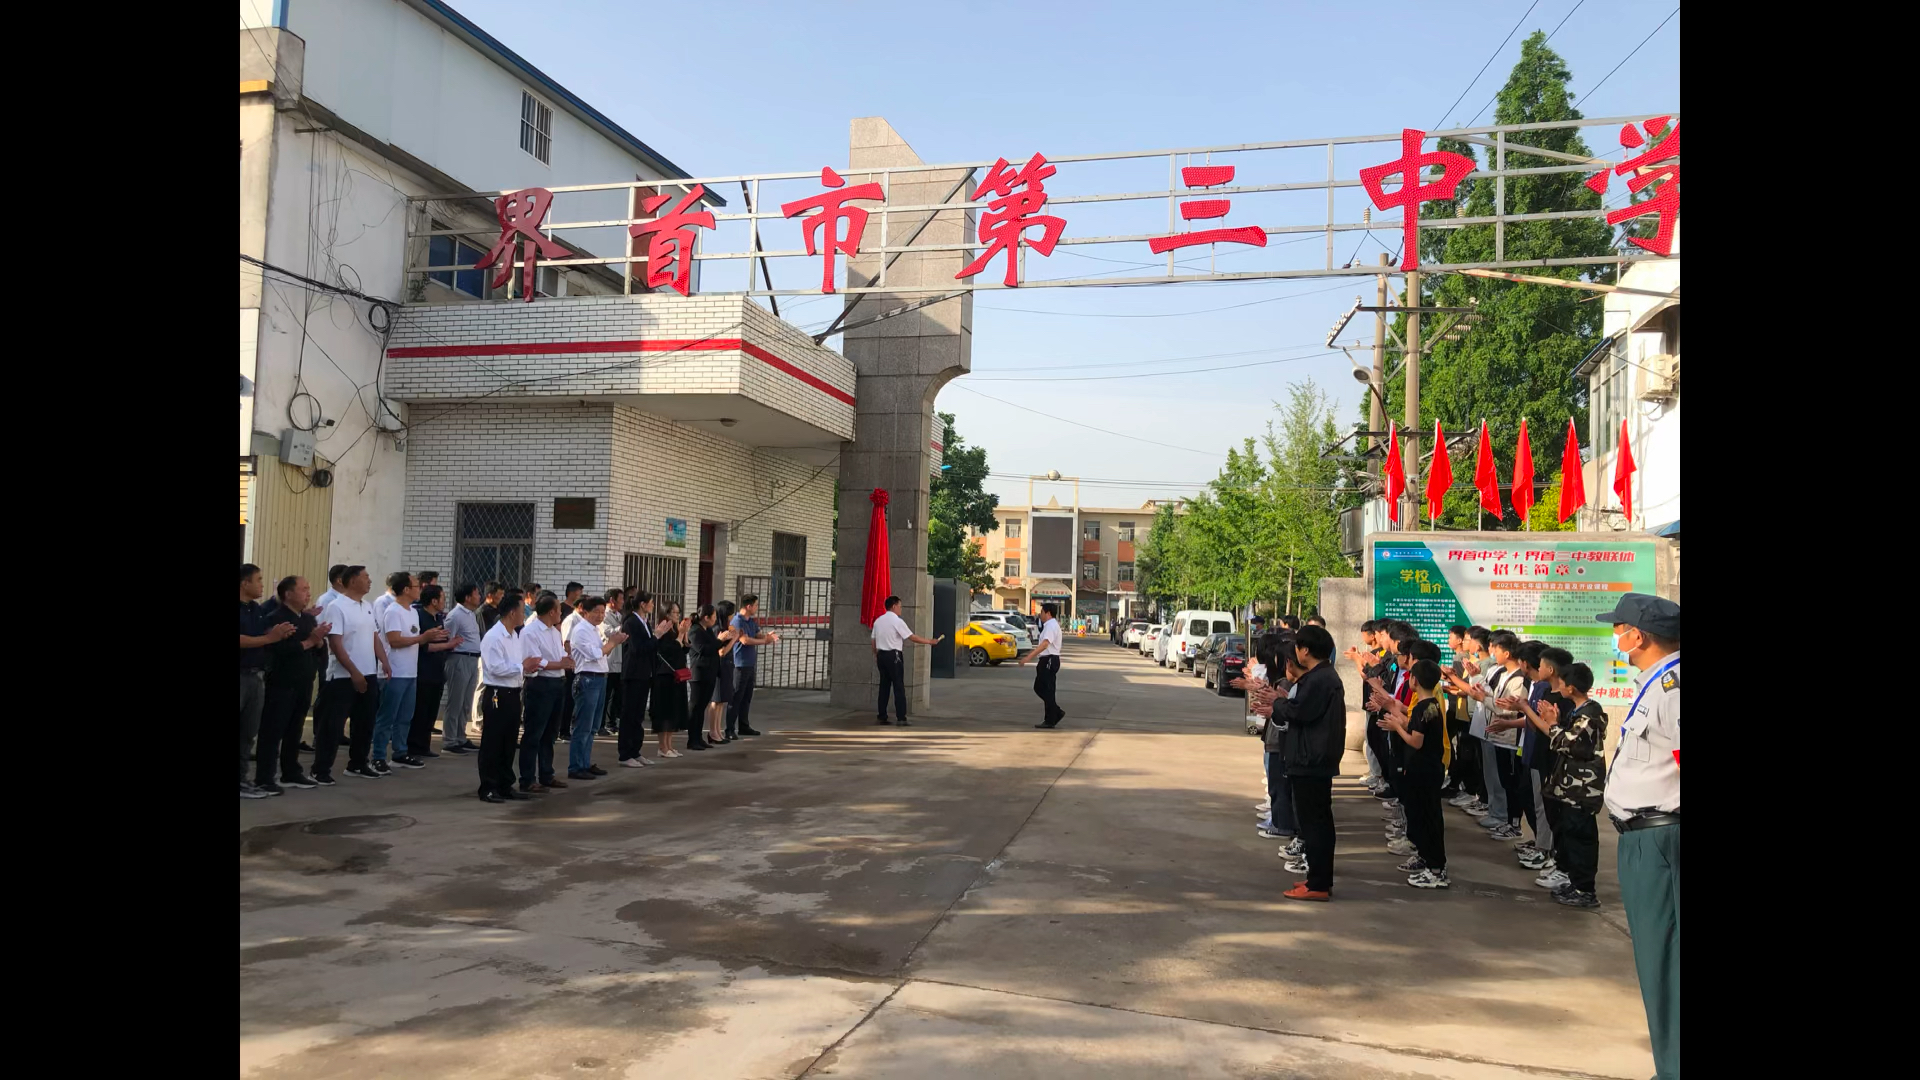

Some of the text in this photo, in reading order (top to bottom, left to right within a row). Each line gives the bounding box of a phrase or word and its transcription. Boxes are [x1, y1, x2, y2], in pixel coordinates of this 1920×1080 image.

[474, 115, 1680, 302] 界首市第三中学
[1400, 569, 1429, 583] 学校
[1493, 563, 1569, 576] 招生简章
[1420, 581, 1442, 594] 简介
